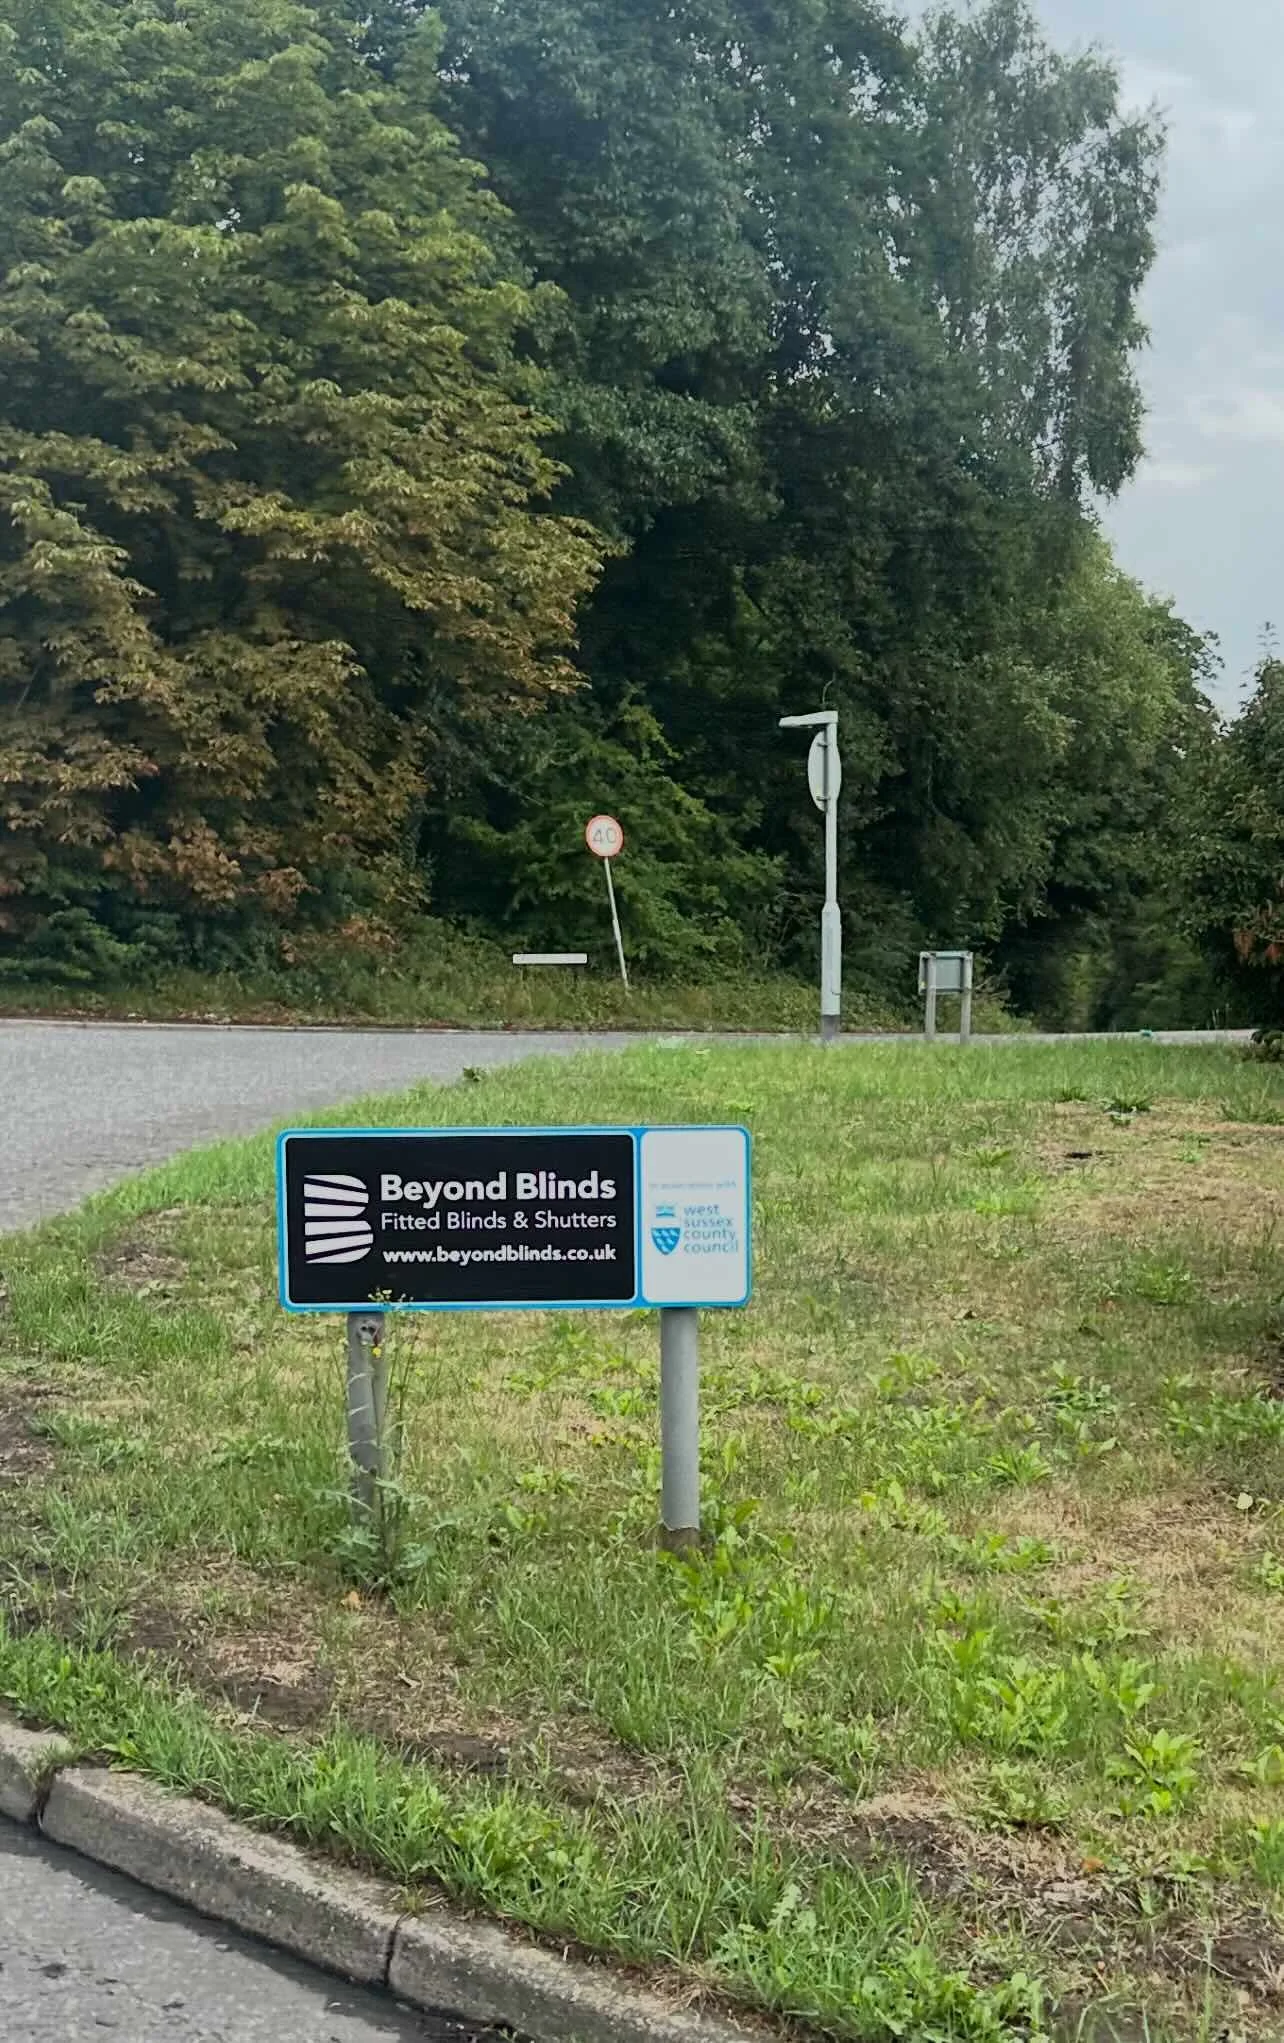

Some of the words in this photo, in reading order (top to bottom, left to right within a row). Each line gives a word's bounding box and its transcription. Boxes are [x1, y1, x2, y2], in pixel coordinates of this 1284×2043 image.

[592, 827, 617, 844] 40
[381, 1171, 508, 1208] Beyond
[516, 1169, 617, 1201] Blinds
[684, 1204, 720, 1217] west
[382, 1211, 441, 1231] Fitted
[448, 1210, 508, 1230] Blinds
[513, 1212, 529, 1229] &
[535, 1210, 617, 1230] Shutters
[684, 1217, 734, 1228] sussex
[684, 1228, 736, 1241] county
[382, 1243, 617, 1266] www.beyondblinds.co.uk
[684, 1240, 739, 1254] council
